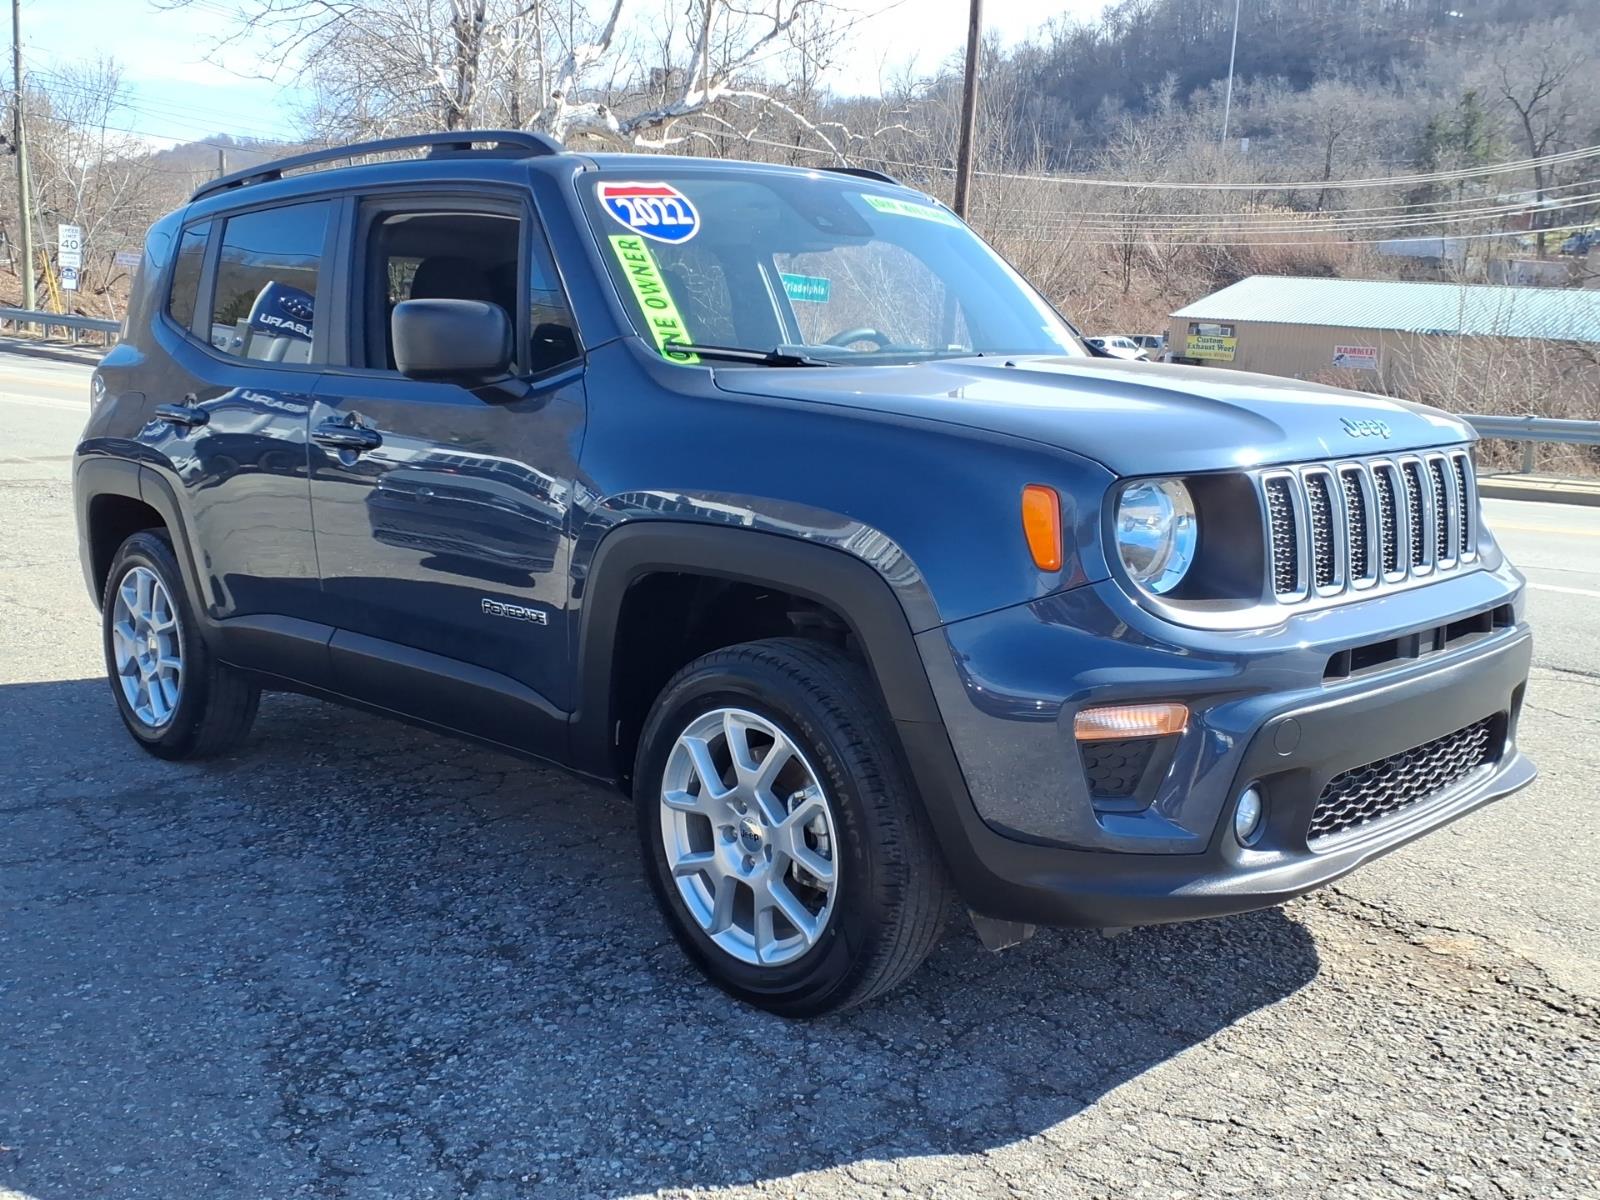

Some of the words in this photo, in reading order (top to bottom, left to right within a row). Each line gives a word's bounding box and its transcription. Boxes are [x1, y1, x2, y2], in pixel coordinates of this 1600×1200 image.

[615, 198, 695, 226] 2022
[61, 239, 79, 249] 40
[618, 240, 668, 309] OWNER
[1339, 417, 1392, 440] Jeep
[481, 598, 548, 625] RENEGADE
[741, 829, 760, 842] Jeep
